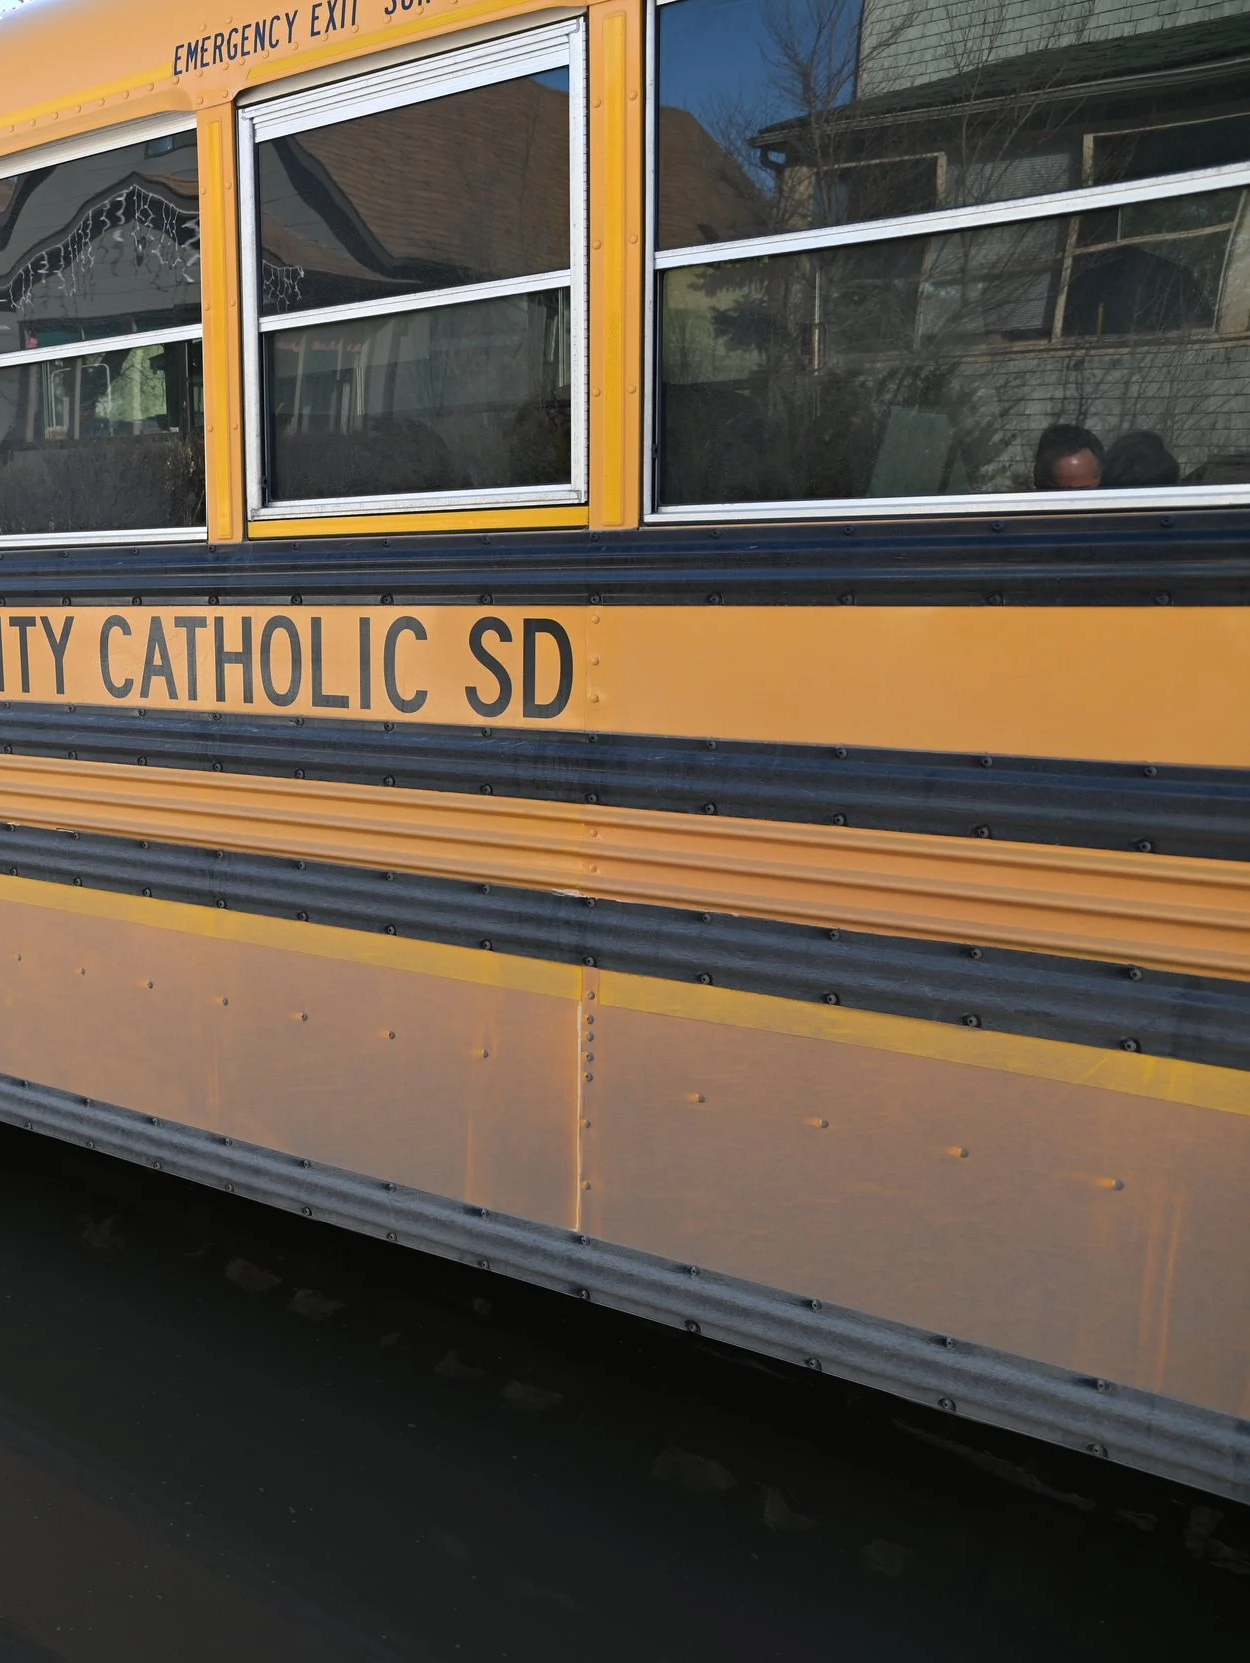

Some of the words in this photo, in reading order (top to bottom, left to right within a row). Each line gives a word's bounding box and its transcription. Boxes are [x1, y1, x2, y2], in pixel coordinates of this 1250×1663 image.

[174, 10, 299, 76] EMERGENCY
[310, 0, 358, 37] EXIT
[99, 615, 428, 714] CATHOLIC
[465, 616, 574, 719] SD
